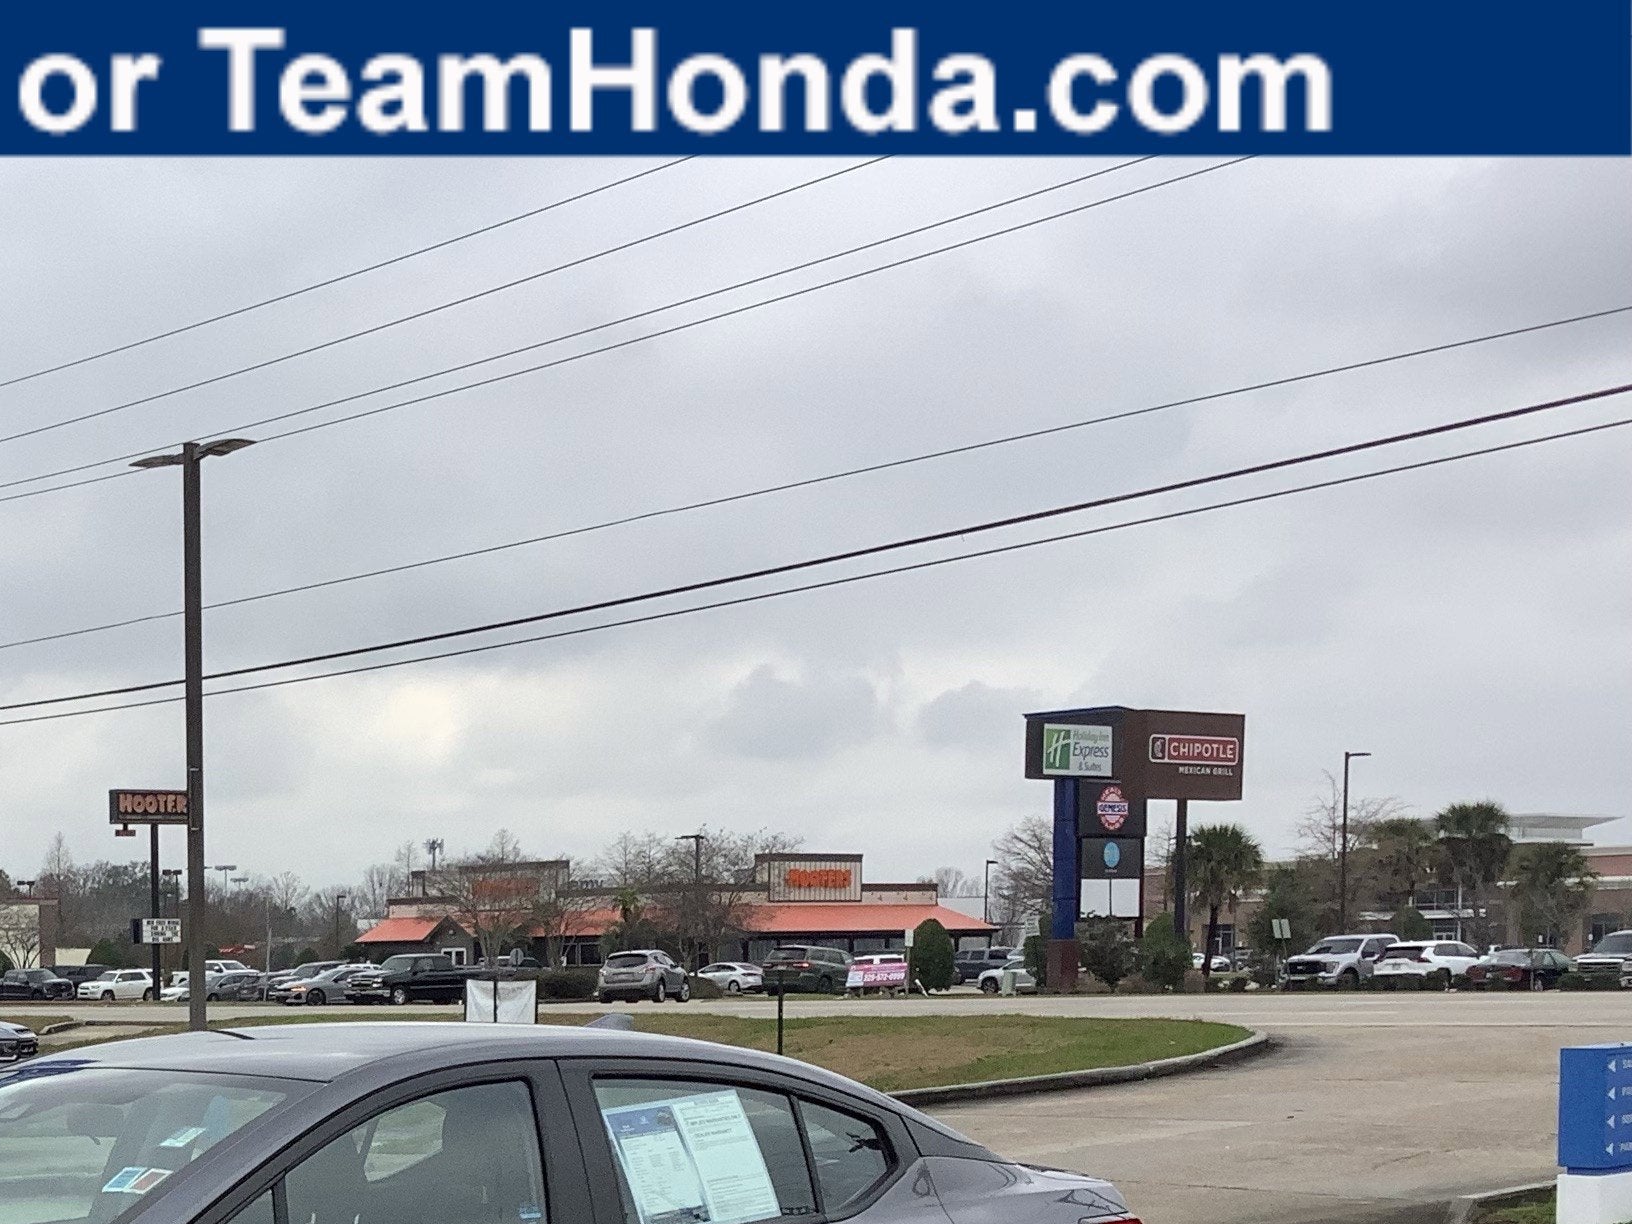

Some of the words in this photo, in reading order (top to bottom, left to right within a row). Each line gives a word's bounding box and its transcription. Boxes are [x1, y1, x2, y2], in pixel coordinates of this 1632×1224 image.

[1072, 742, 1109, 760] Express
[1170, 742, 1234, 758] CHIPOTLE
[1178, 766, 1211, 775] MEXICAN
[1212, 767, 1234, 776] GRILL
[119, 793, 188, 814] HOOTER
